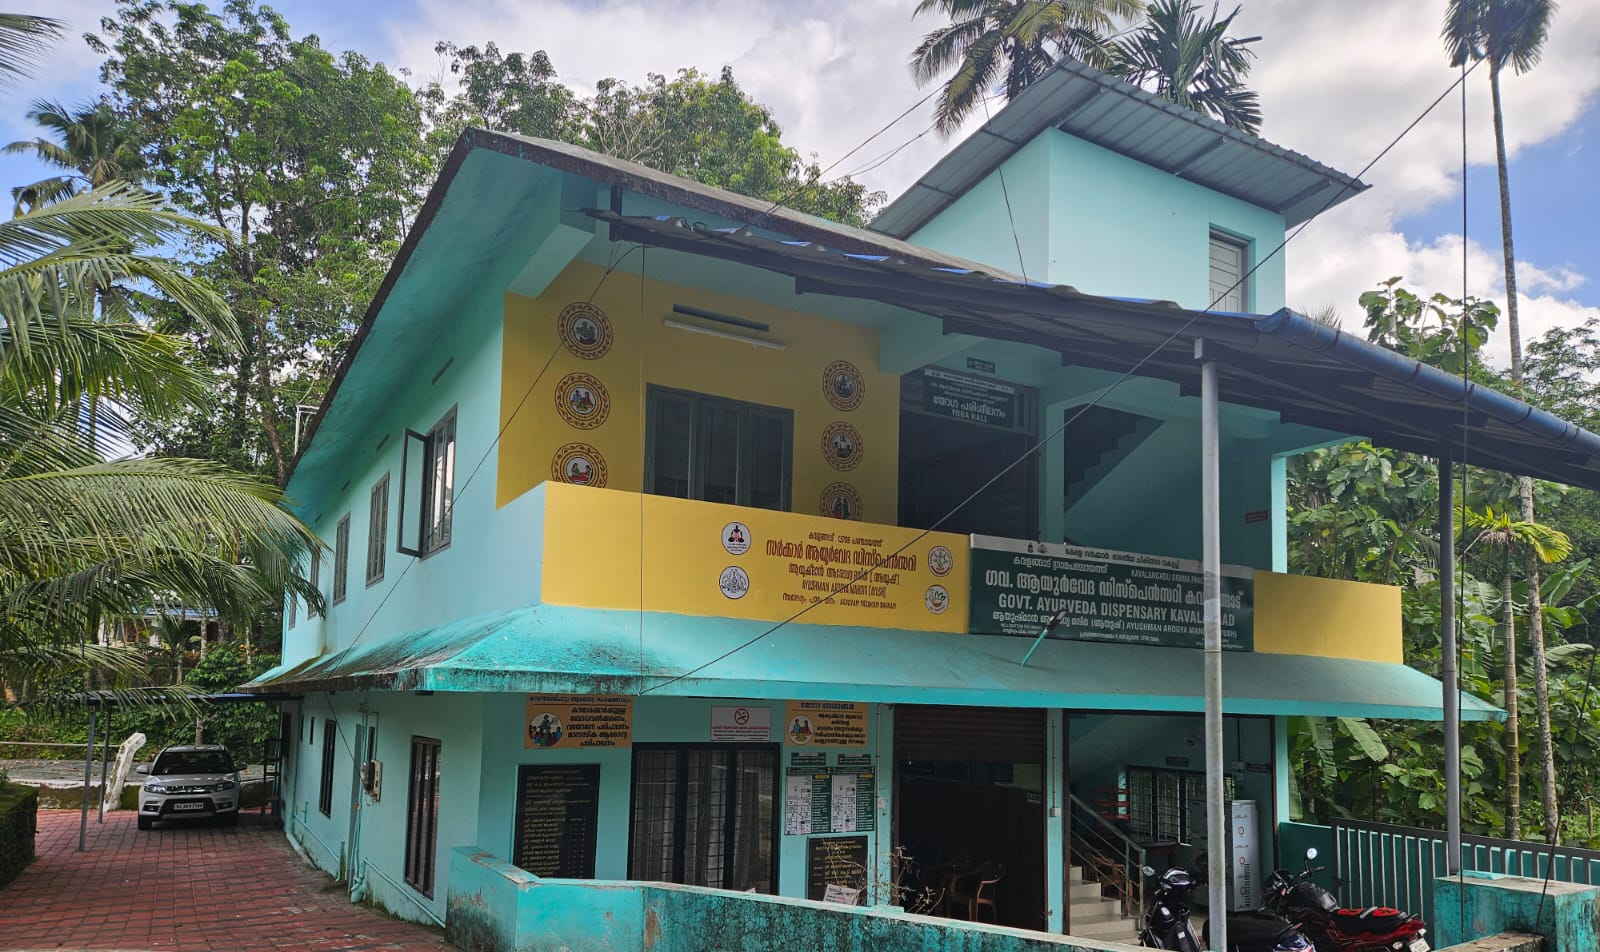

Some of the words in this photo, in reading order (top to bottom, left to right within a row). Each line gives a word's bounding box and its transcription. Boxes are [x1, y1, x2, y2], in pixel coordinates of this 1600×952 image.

[951, 408, 969, 419] YOGA
[971, 412, 988, 423] HALL
[766, 539, 803, 559] സർക്കാർ
[985, 569, 1014, 588] ഗവ.
[1016, 572, 1095, 596] ആയുർവേദ
[1099, 576, 1183, 603] ഡിസ്പെൻസറി
[998, 593, 1033, 610] GOVT.
[1037, 596, 1098, 615] AYURVEDA
[1101, 602, 1168, 621] DISPENSARY
[1170, 607, 1236, 627] KAVALAD
[1126, 621, 1162, 633] AYUSHMAN
[1163, 624, 1187, 634] AROGYA
